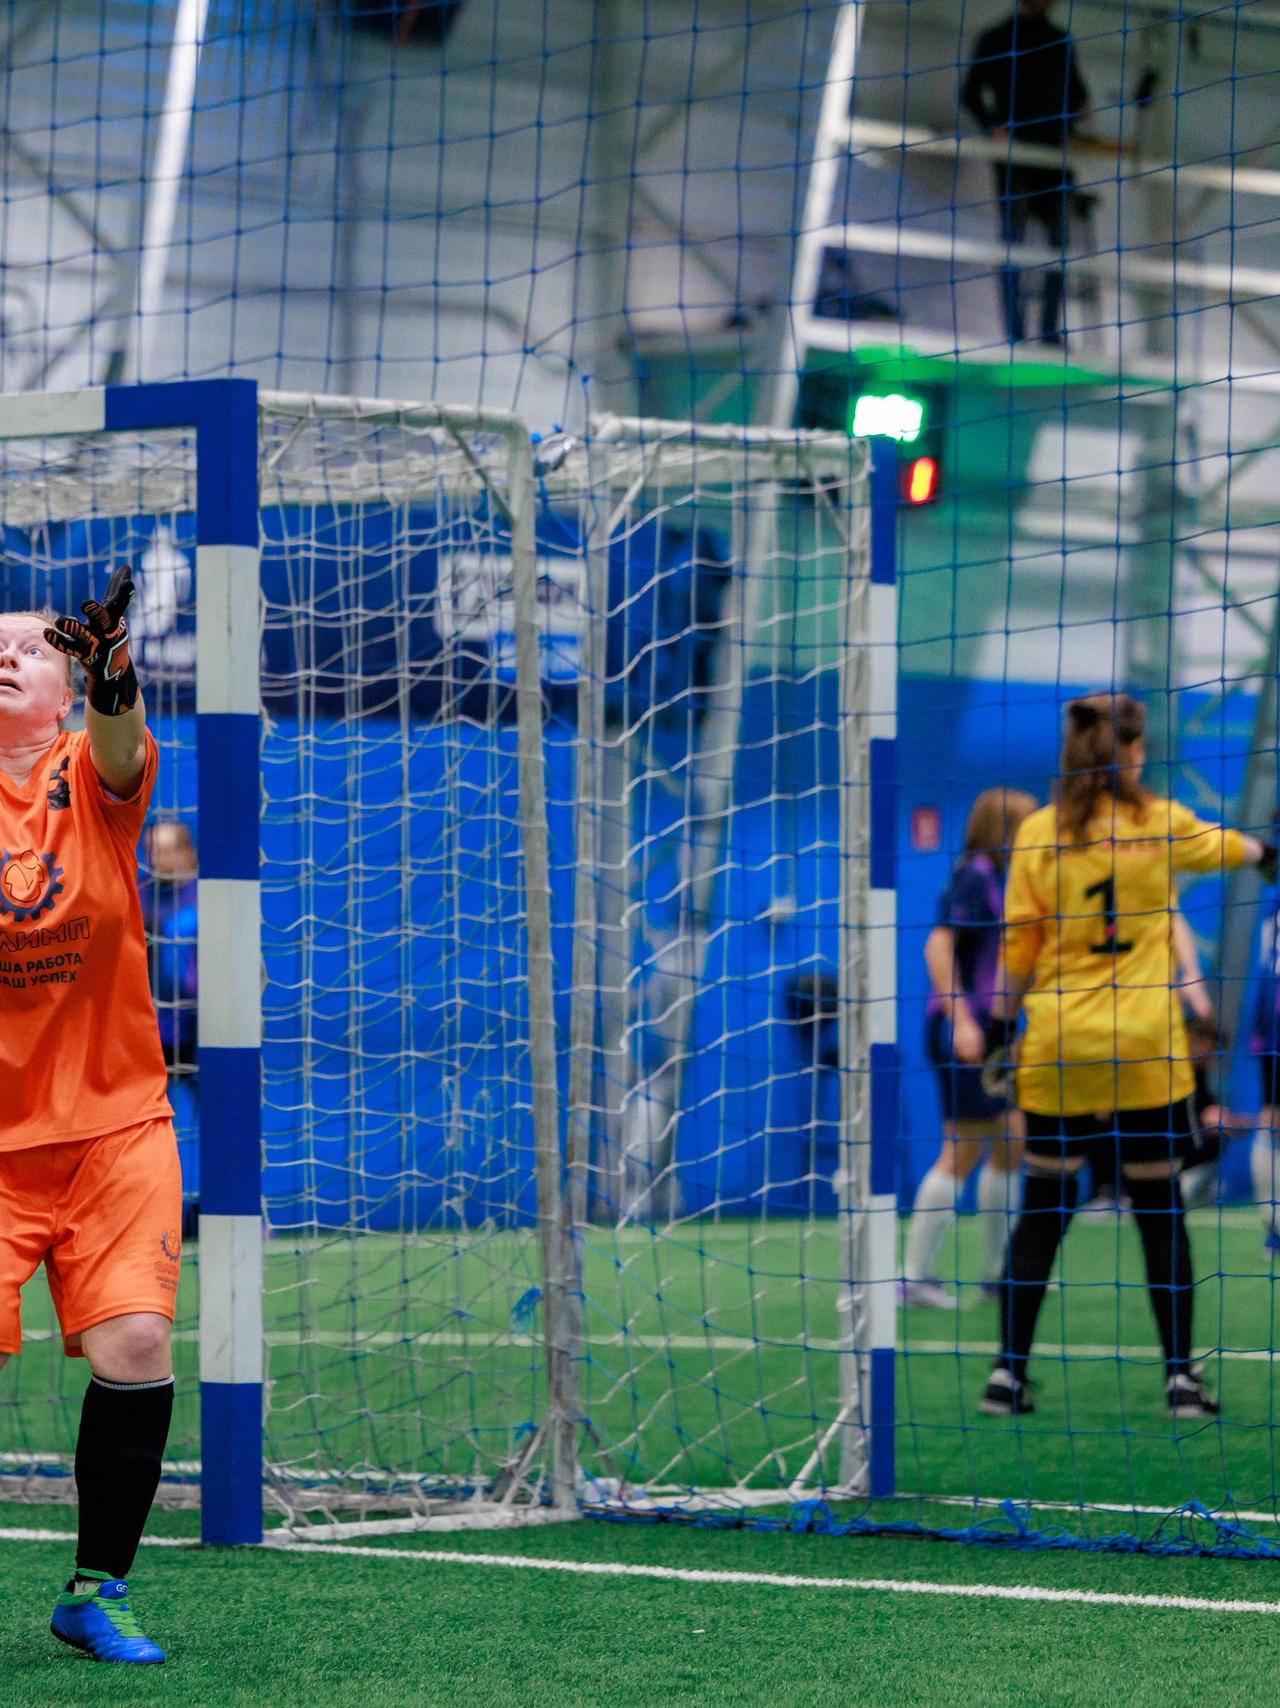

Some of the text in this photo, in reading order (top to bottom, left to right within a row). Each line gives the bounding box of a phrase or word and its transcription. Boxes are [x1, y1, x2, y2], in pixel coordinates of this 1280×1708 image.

[1085, 876, 1133, 956] 1
[26, 953, 82, 972] РАБОТА
[30, 970, 77, 986] УСПЕХ
